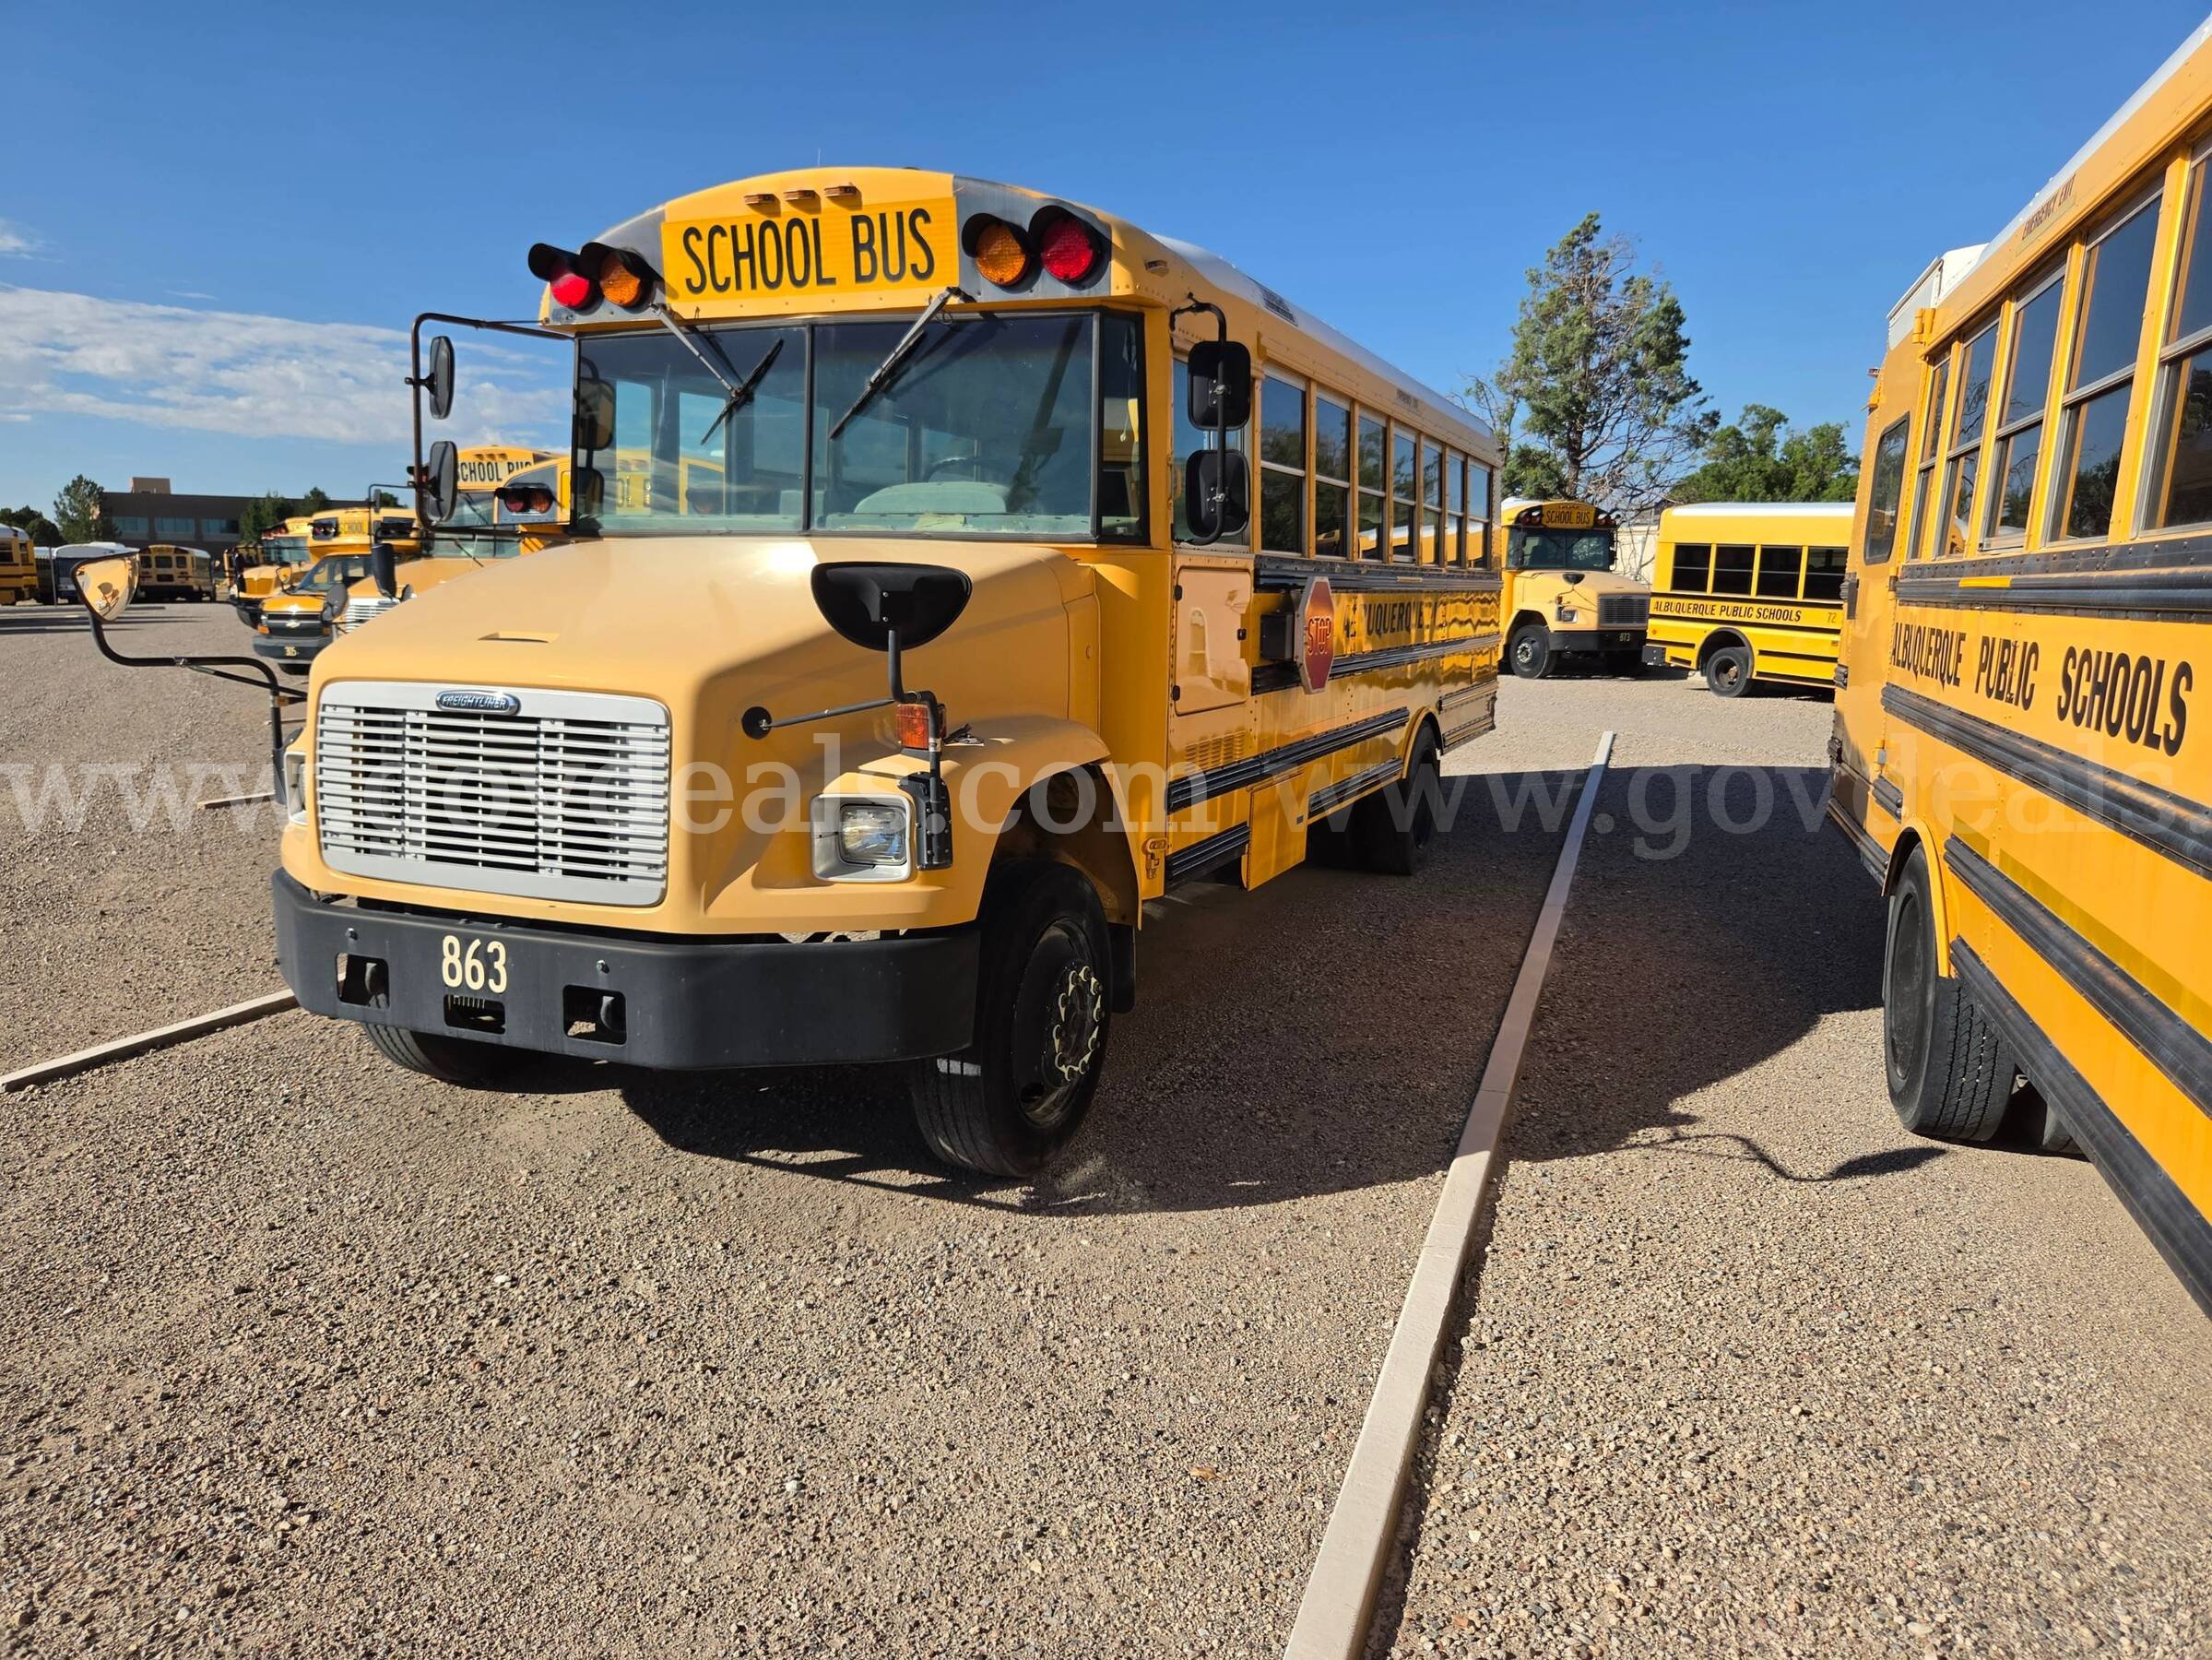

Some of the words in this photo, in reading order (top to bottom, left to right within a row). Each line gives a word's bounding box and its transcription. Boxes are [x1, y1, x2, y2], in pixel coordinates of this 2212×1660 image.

[682, 218, 836, 294] SCHOOL
[851, 208, 935, 284] BUS
[457, 461, 503, 482] CHOOL
[1546, 510, 1573, 525] SCHOOL
[1576, 511, 1591, 525] BUS
[1654, 600, 1716, 616] ALBUQUERQUE
[1720, 605, 1754, 619] PUBLIC
[1756, 608, 1802, 622] SCHOOLS
[1307, 617, 1331, 656] STOP
[442, 694, 506, 709] FREIGHTLINER
[1891, 622, 1966, 692] ALBUQUERQUE
[1974, 634, 2039, 711] PUBLIC
[2057, 646, 2194, 757] SCHOOLS
[442, 934, 507, 993] 863
